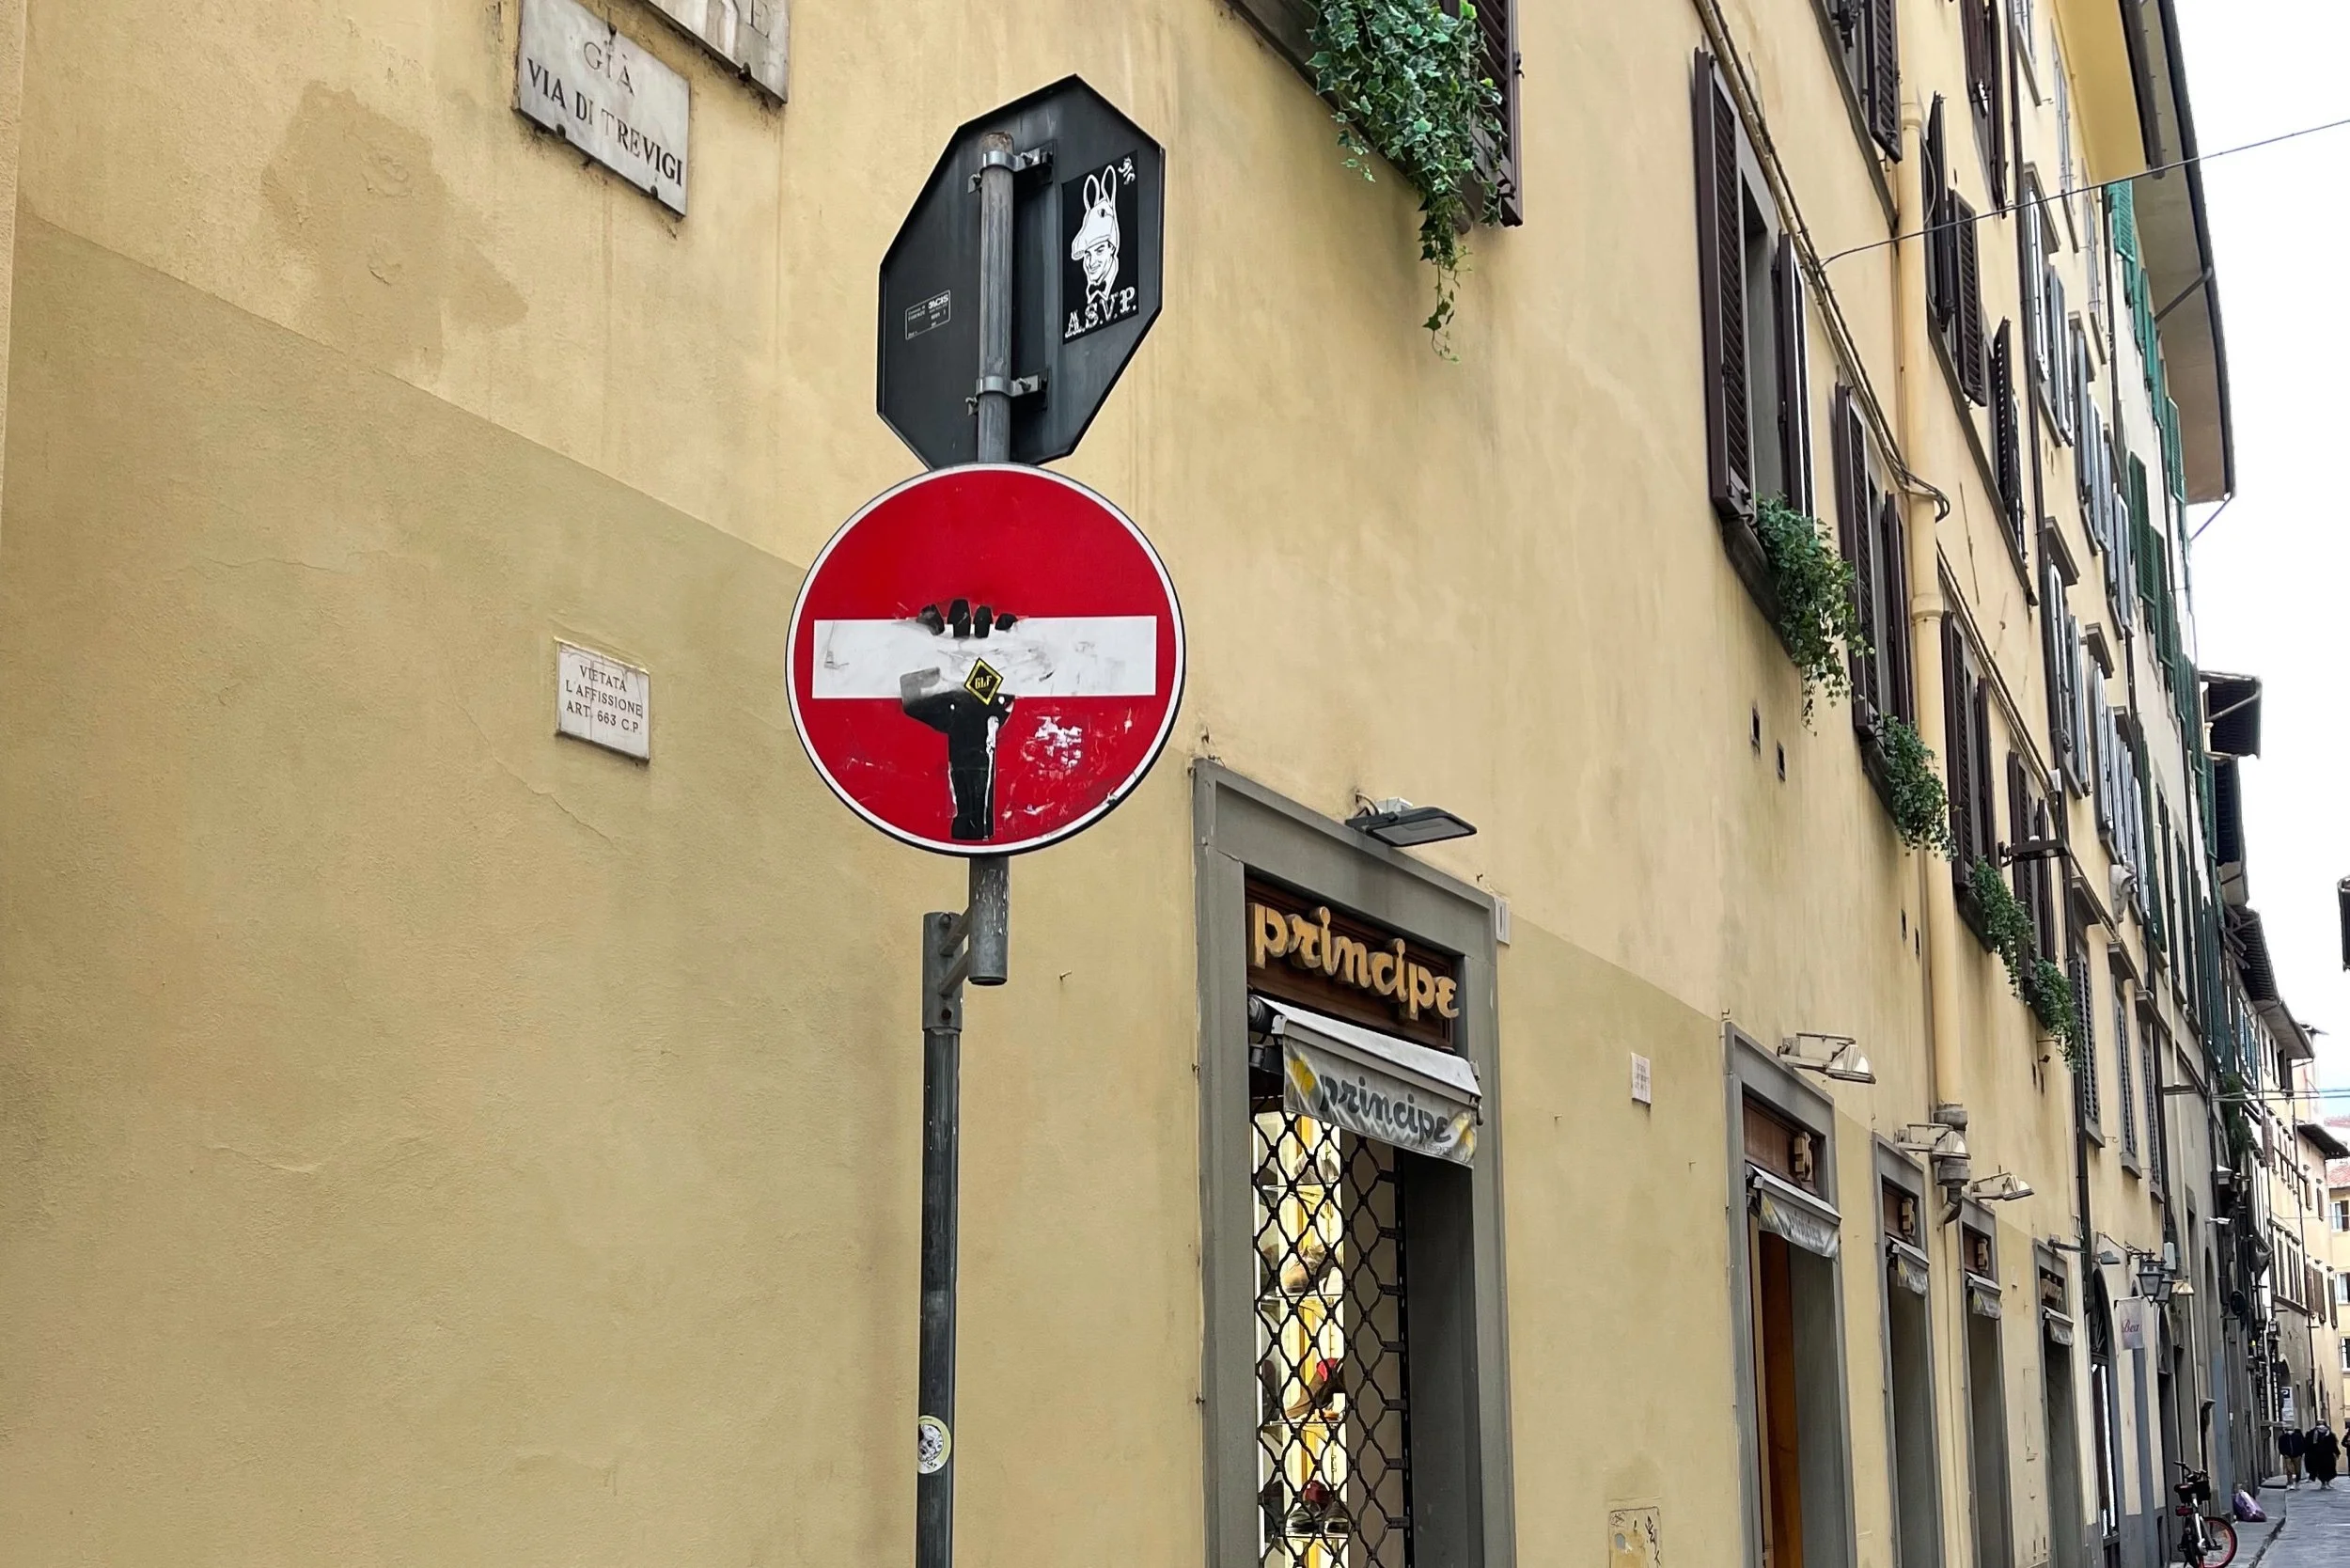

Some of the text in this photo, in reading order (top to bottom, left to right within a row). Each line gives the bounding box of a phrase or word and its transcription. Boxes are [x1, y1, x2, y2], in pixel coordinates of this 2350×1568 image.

[584, 40, 636, 97] GIÀ
[527, 57, 683, 187] VIA DI TREVIGI
[579, 665, 627, 692] VIETATA
[597, 710, 617, 727] 663
[1246, 902, 1460, 1021] principe
[1319, 1074, 1452, 1143] principe
